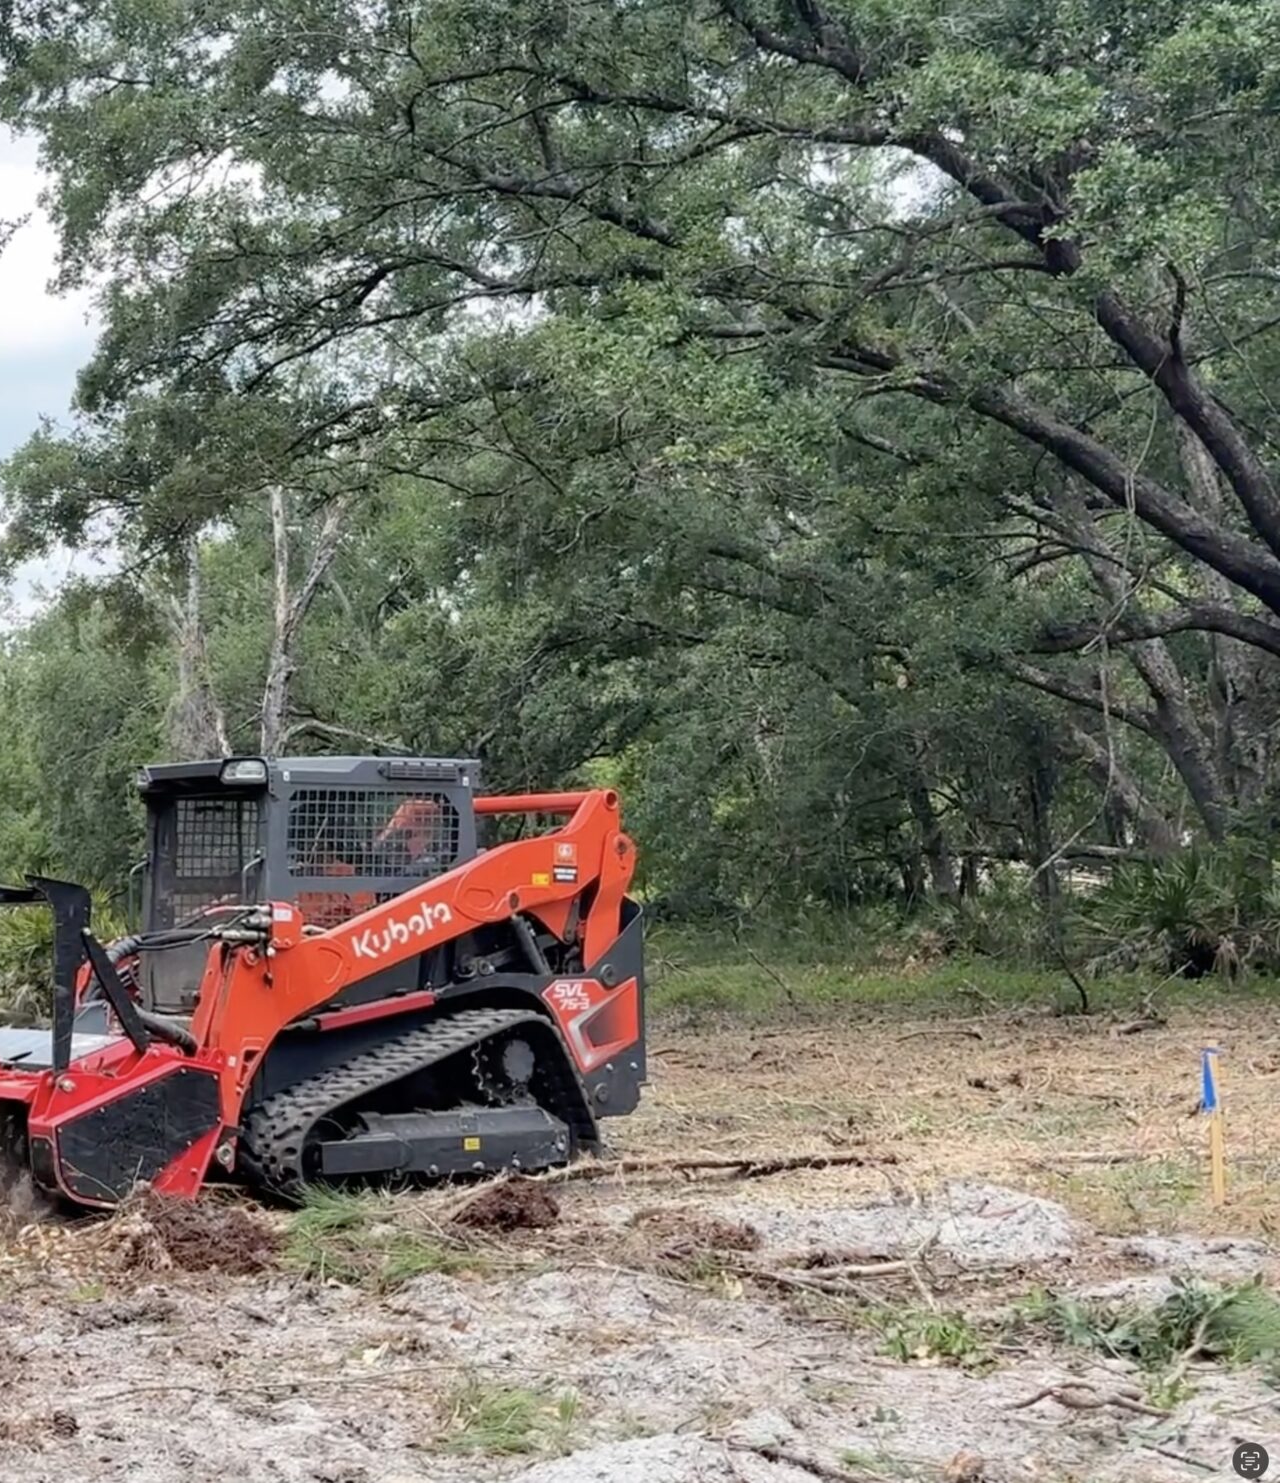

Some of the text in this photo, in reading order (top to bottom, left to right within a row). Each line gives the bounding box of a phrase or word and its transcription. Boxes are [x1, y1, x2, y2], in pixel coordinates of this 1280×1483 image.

[351, 901, 452, 959] Kubota
[552, 983, 588, 998] SVL
[559, 998, 590, 1010] 75-3
